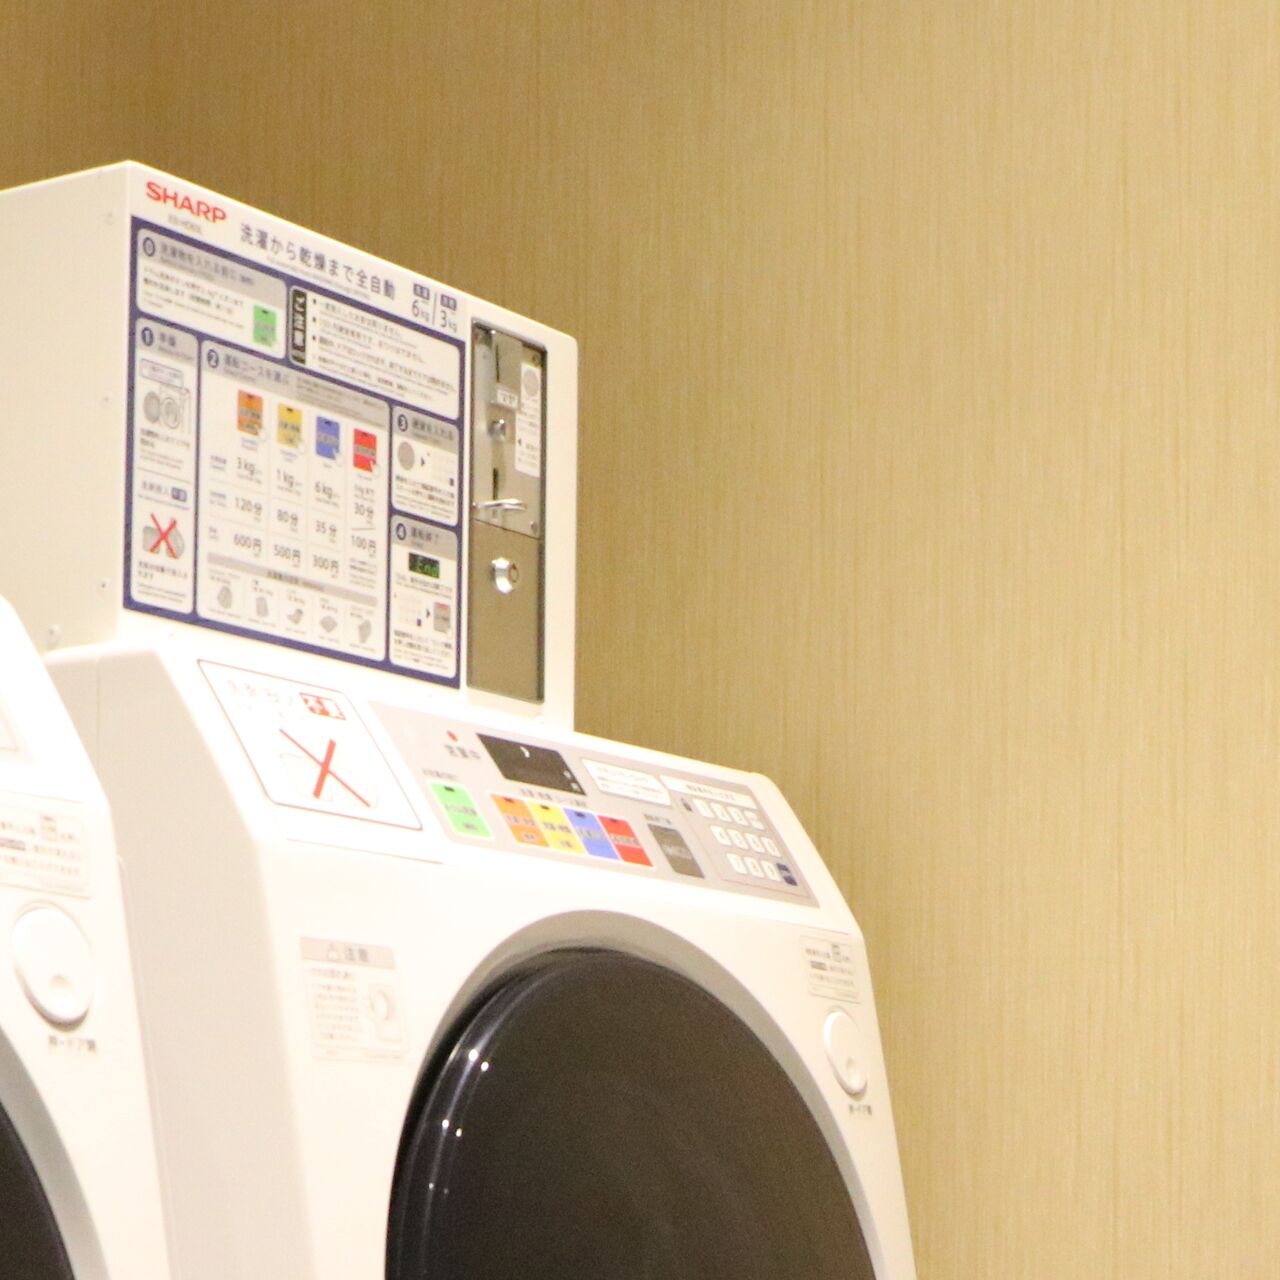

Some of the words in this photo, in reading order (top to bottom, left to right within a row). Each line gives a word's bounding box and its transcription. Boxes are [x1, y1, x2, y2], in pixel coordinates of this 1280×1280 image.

[146, 180, 228, 223] SHARP
[239, 221, 395, 301] 洗濯から乾燥まで全自動
